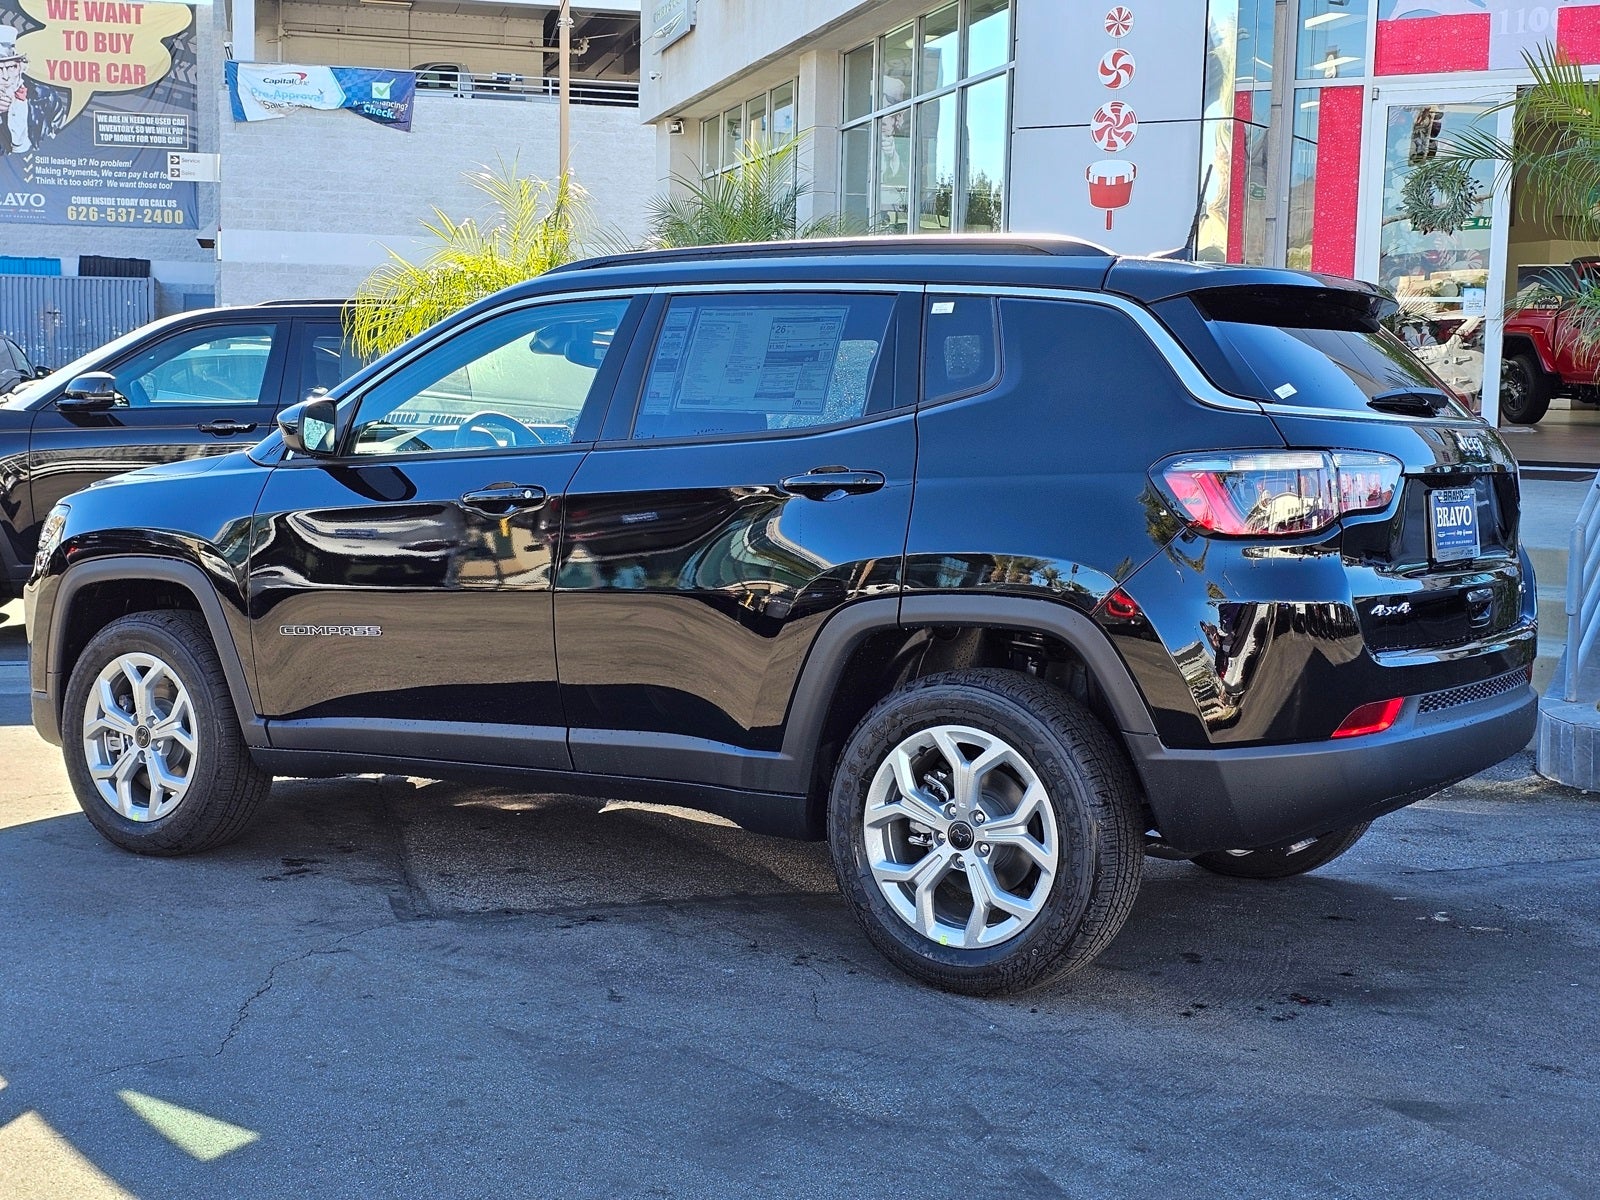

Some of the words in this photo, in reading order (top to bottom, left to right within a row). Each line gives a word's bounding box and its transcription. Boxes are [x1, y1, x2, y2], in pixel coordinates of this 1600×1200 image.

[46, 0, 79, 20] WE
[83, 1, 144, 25] WANT
[1497, 7, 1558, 35] 110
[62, 30, 88, 52] TO
[94, 31, 134, 54] BUY
[46, 59, 101, 82] YOUR
[106, 62, 146, 85] CAR
[363, 104, 396, 119] Check.
[97, 115, 108, 123] WE
[108, 115, 121, 123] ARE
[129, 116, 145, 124] NEED
[146, 117, 154, 125] OF
[155, 117, 171, 125] USED
[172, 118, 185, 126] CAR
[135, 126, 144, 134] SO
[145, 126, 155, 134] WE
[156, 127, 171, 135] WILL
[172, 127, 184, 135] PAY
[100, 133, 113, 141] TOP
[114, 134, 136, 143] MONEY
[137, 135, 149, 143] FOR
[149, 135, 167, 144] YOUR
[167, 136, 183, 145] CAR!
[35, 155, 49, 164] Still
[51, 156, 76, 167] leasing
[77, 157, 87, 166] it?
[88, 158, 99, 166] No
[100, 159, 133, 168] problem!
[35, 166, 61, 176] Making
[62, 167, 100, 178] Payments,
[101, 169, 112, 177] We
[142, 170, 148, 178] it
[148, 171, 159, 179] off
[35, 176, 56, 185] Think
[57, 177, 68, 186] it's
[69, 178, 81, 186] too
[82, 179, 103, 187] old??
[106, 179, 118, 188] We
[118, 180, 137, 188] want
[137, 181, 158, 189] those
[158, 182, 173, 190] too!
[0, 192, 46, 208] AVO
[71, 196, 91, 205] COME
[92, 196, 116, 206] INSIDE
[116, 198, 139, 206] TODAY
[139, 198, 150, 207] OR
[150, 199, 166, 207] CALL
[167, 199, 177, 208] US
[67, 205, 184, 225] 626-537-2400
[1436, 505, 1473, 528] BRAVO
[279, 625, 383, 637] COMPASS
